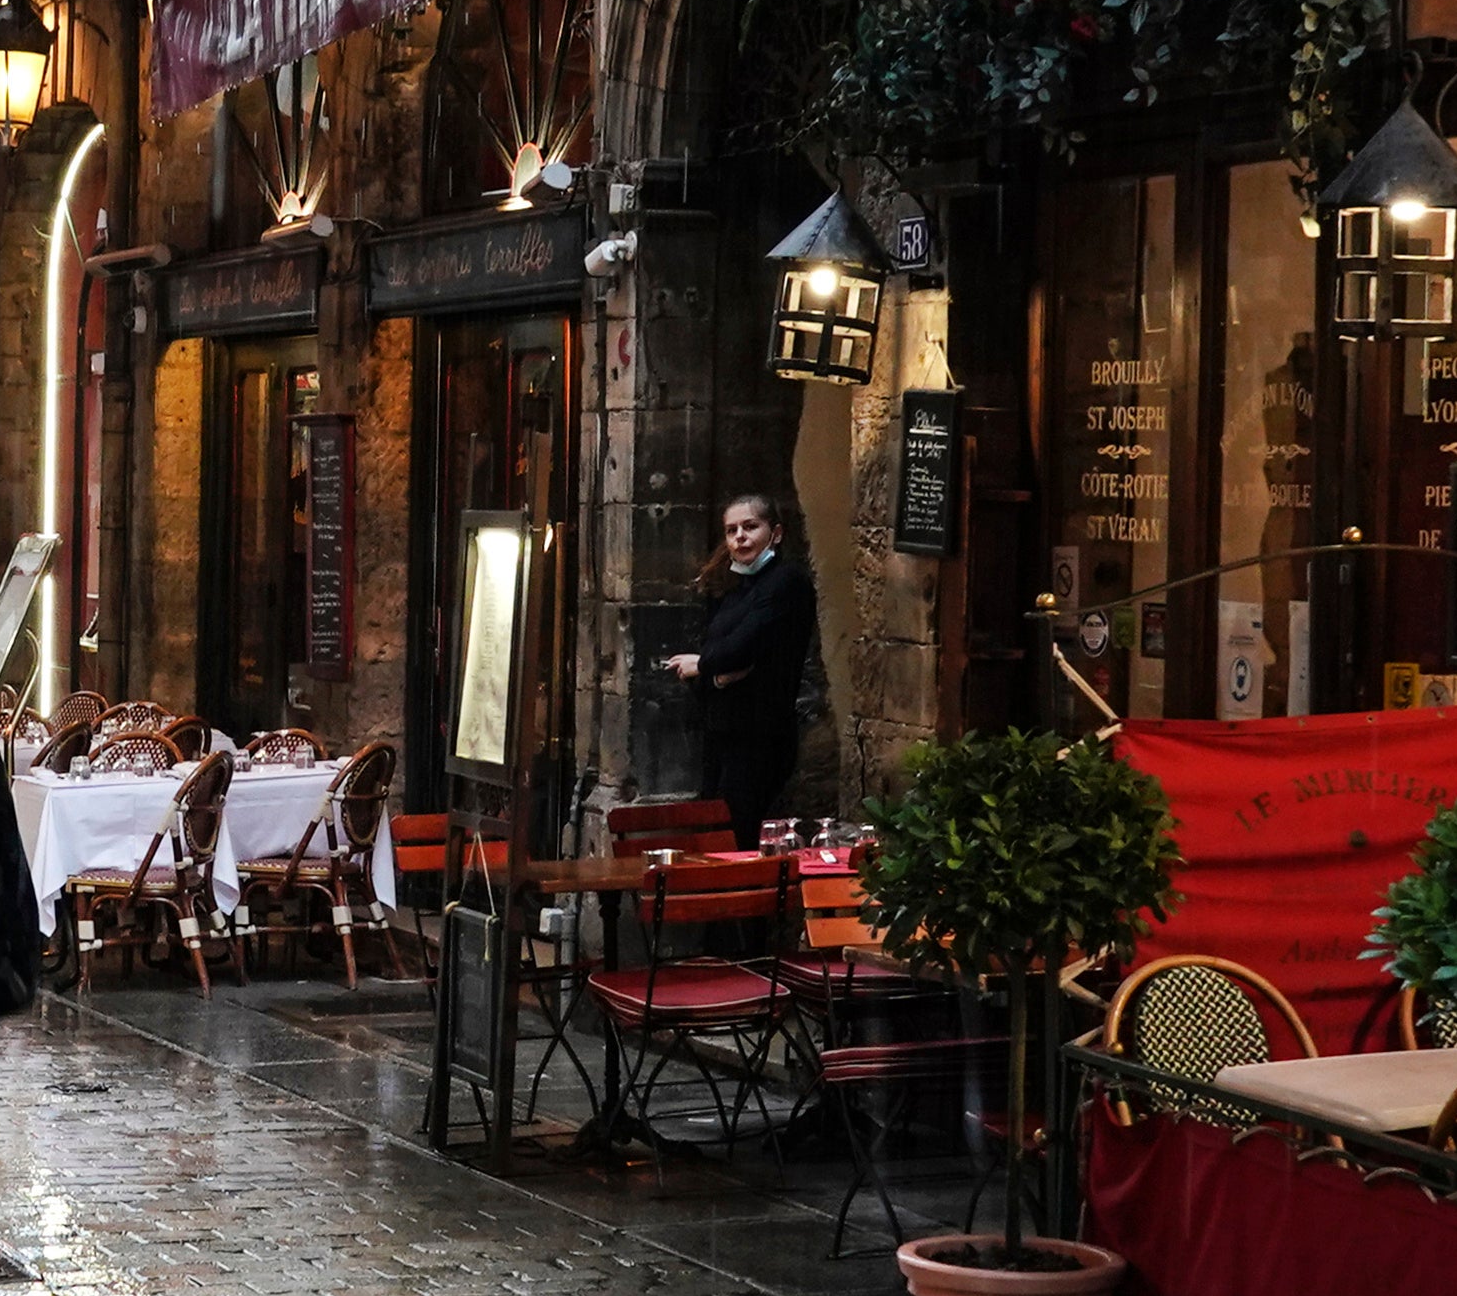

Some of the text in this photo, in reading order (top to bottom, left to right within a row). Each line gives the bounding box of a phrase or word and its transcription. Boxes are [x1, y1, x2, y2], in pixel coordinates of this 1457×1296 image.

[901, 223, 923, 261] 58
[1091, 355, 1167, 387] BROUILLY
[1087, 405, 1166, 431] ST JOSEPH
[1086, 514, 1106, 540] ST
[1233, 790, 1280, 834] LE
